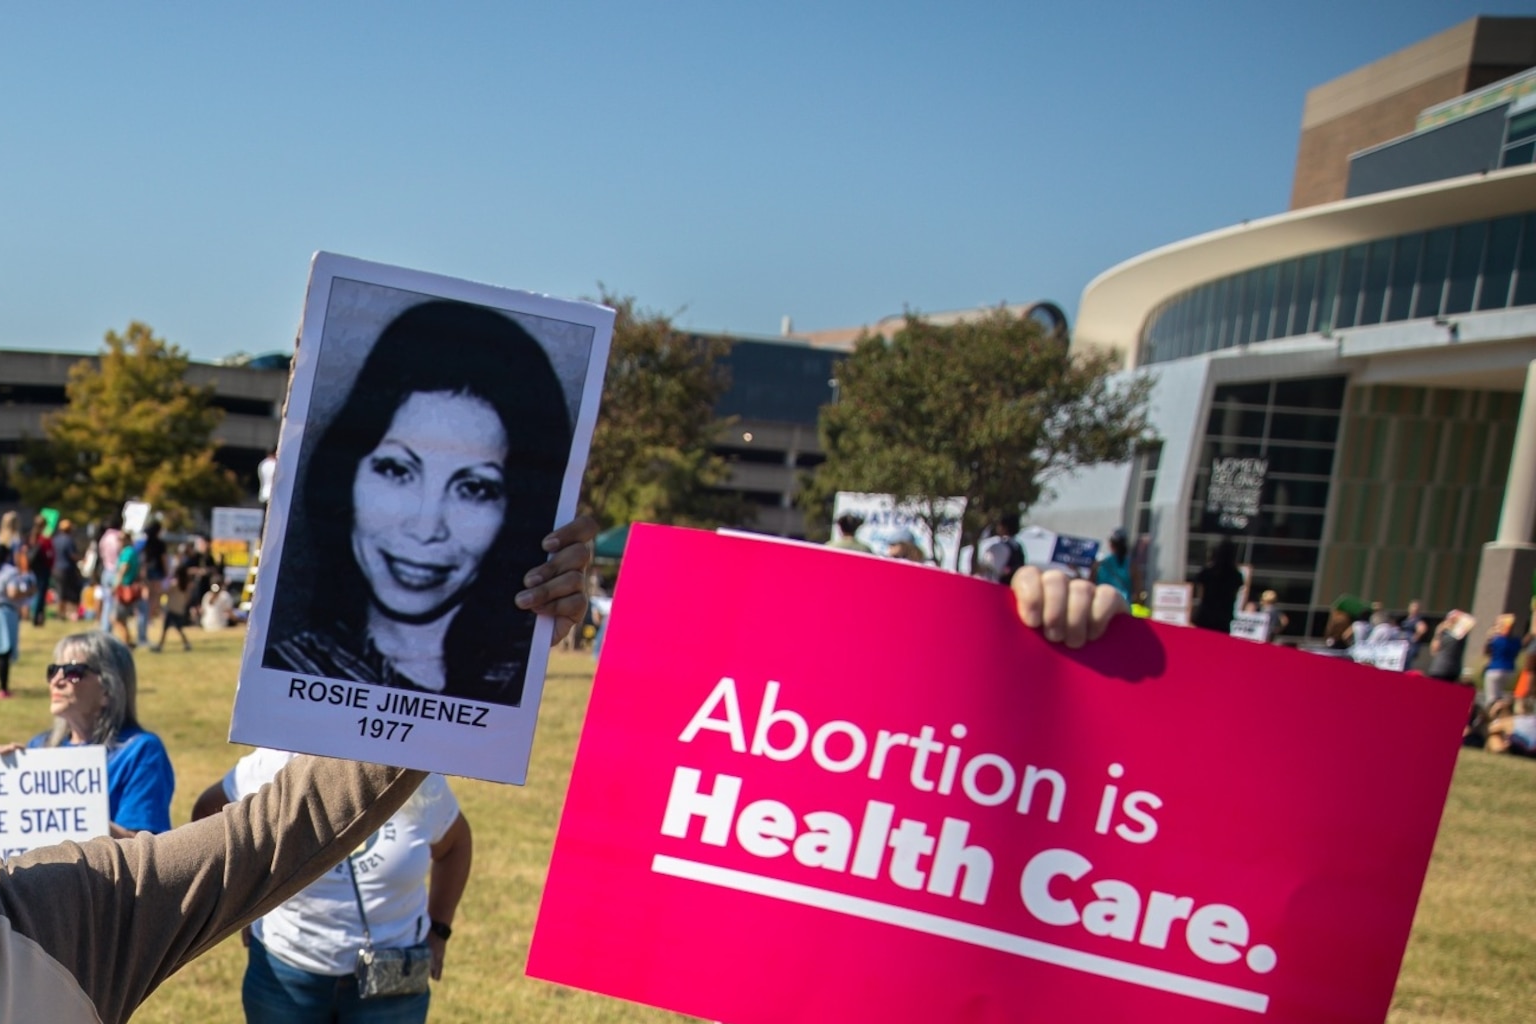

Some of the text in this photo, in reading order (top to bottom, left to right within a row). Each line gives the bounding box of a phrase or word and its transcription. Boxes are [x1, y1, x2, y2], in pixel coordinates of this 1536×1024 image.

[288, 677, 490, 728] ROSIE JIMENEZ
[357, 716, 414, 742] 1977
[678, 676, 1164, 844] Abortion is
[19, 767, 102, 795] CHURCH
[20, 807, 88, 833] STATE
[660, 765, 1278, 973] Health Care.
